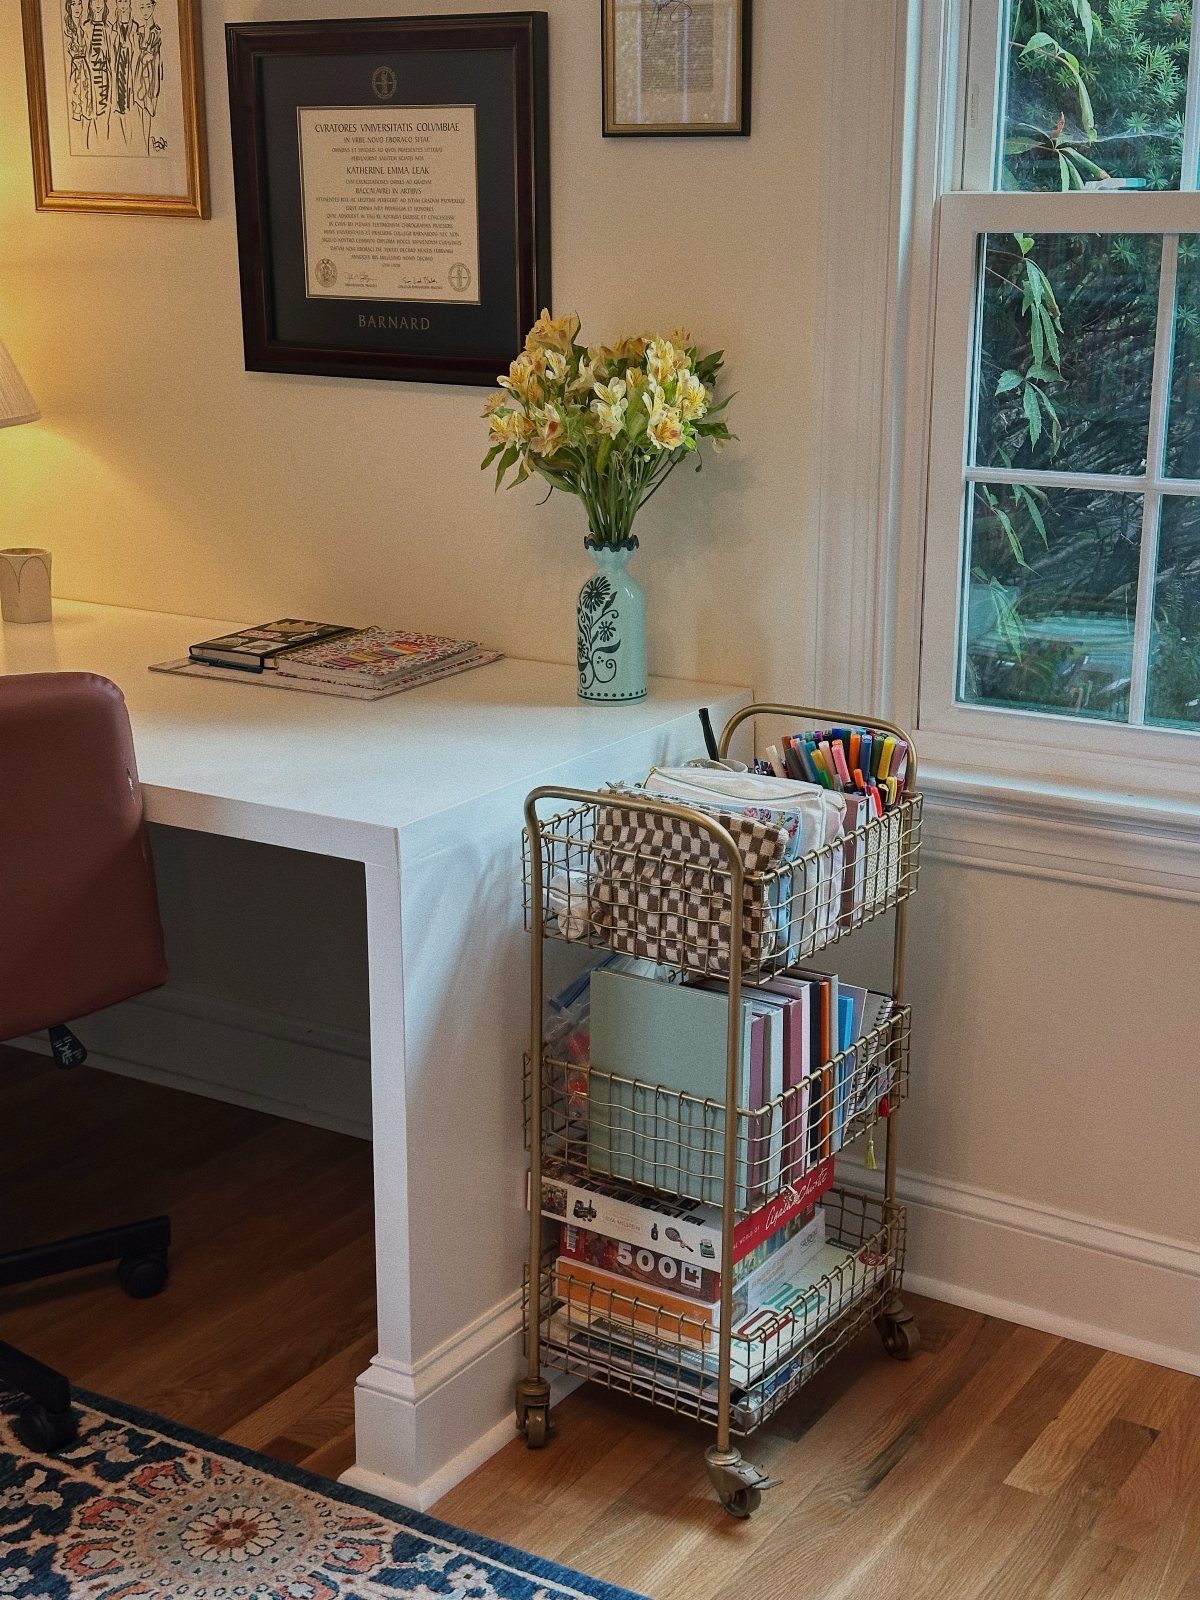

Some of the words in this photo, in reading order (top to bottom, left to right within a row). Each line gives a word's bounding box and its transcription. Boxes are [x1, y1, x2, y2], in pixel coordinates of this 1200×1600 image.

[315, 123, 358, 133] CVRATORES
[360, 123, 413, 132] VNIVERSITATIS
[416, 122, 460, 132] COLVMBIAE
[346, 166, 385, 175] KATHERINE
[387, 166, 410, 175] EMMA
[412, 166, 430, 175] LEAK
[358, 314, 431, 331] BARNARD
[616, 1241, 678, 1280] 500
